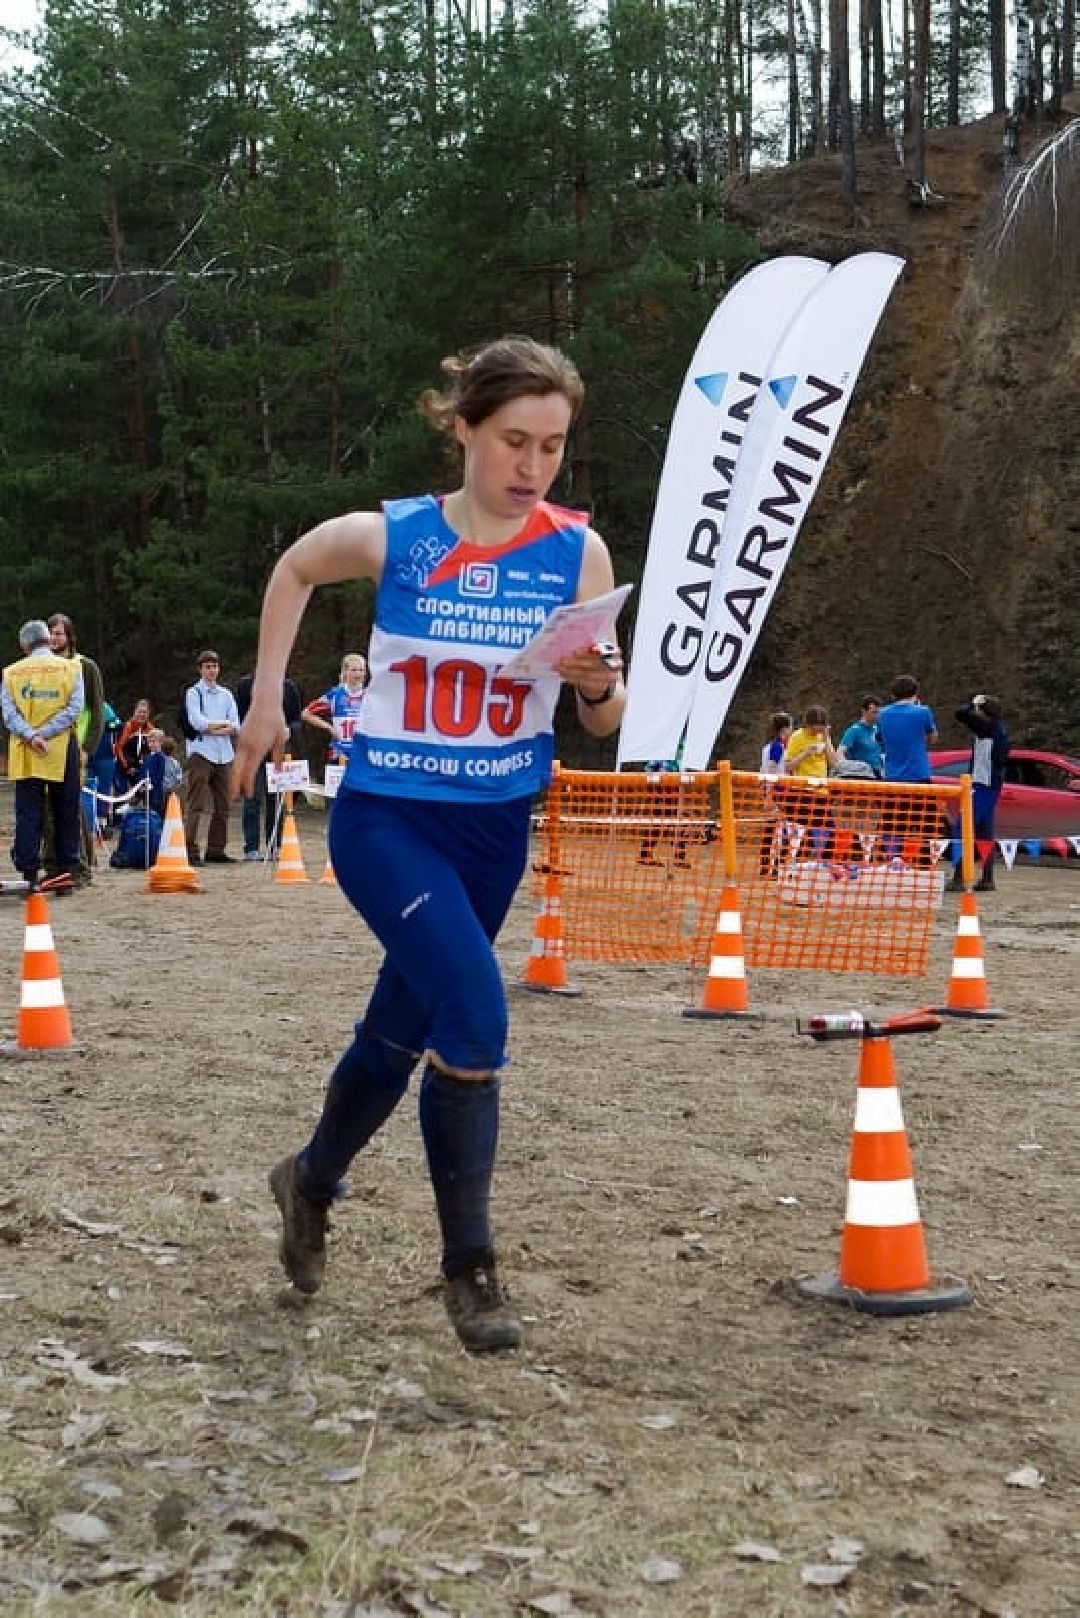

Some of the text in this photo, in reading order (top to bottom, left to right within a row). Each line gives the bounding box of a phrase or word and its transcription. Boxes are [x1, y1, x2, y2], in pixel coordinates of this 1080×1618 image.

[705, 374, 844, 682] GARMIN
[416, 596, 545, 625] СПОРТИВНЫЙ
[429, 618, 534, 646] ЛАБИРИНТ
[367, 749, 460, 775] MOSCOW
